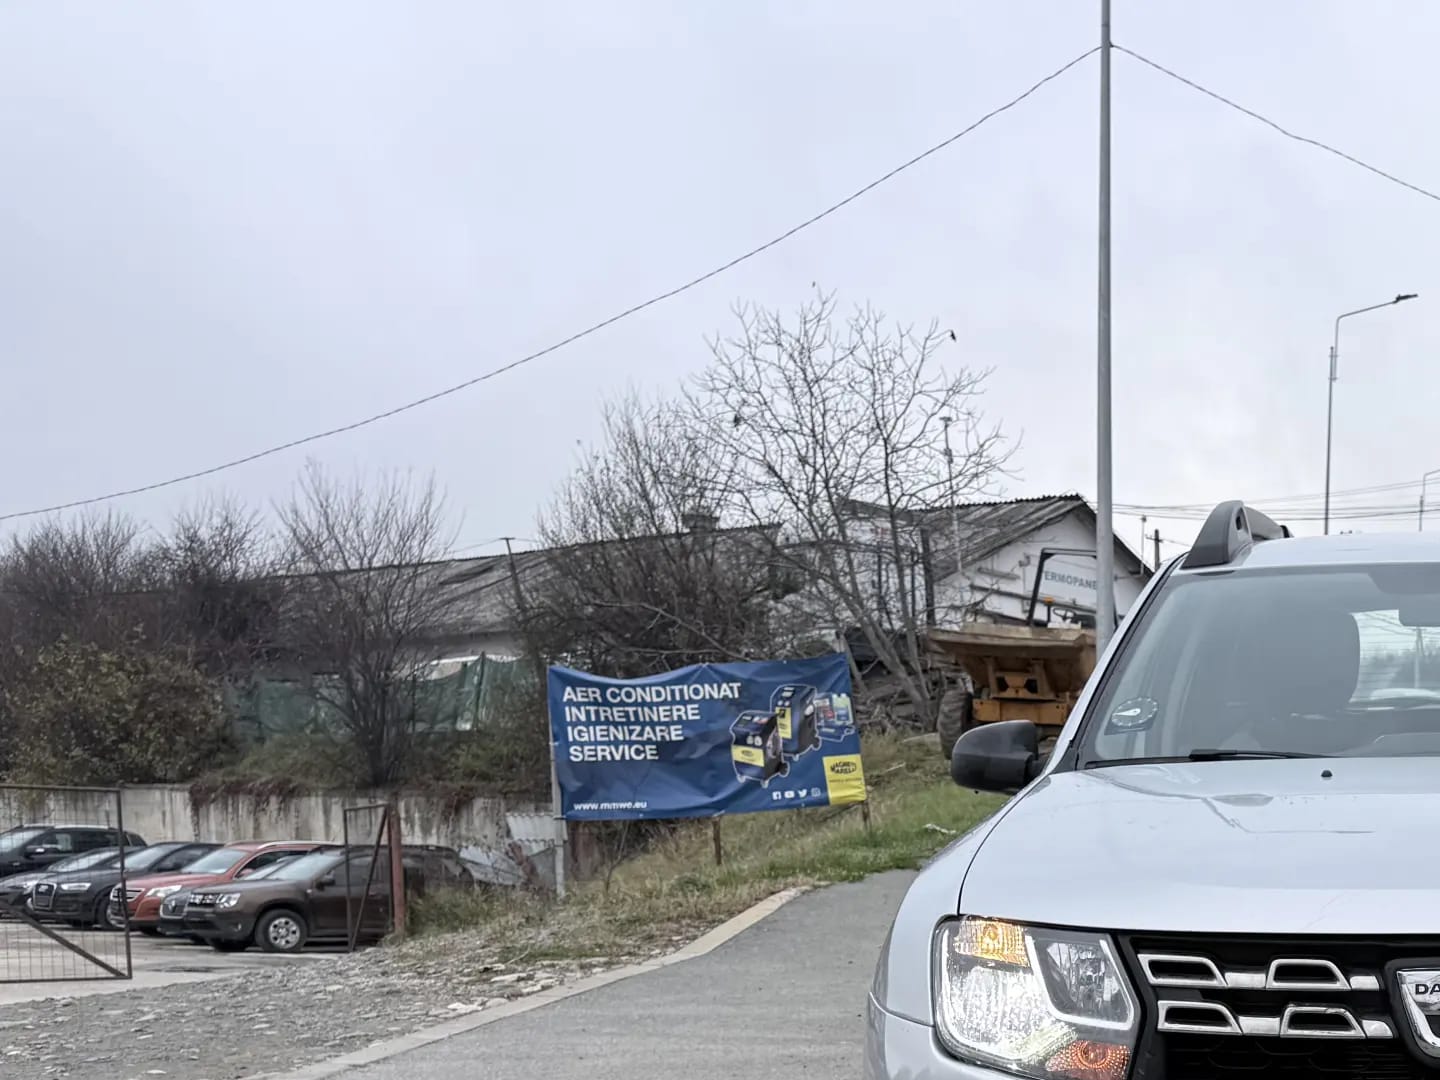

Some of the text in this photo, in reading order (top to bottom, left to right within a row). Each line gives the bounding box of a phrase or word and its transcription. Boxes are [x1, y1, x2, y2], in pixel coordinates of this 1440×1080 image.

[1043, 570, 1097, 590] ERMOPANE
[563, 682, 741, 703] AER CONDITIONAT
[565, 704, 700, 722] INTRETINERE
[568, 725, 684, 742] IGIENIZARE
[570, 745, 659, 762] SERVICE
